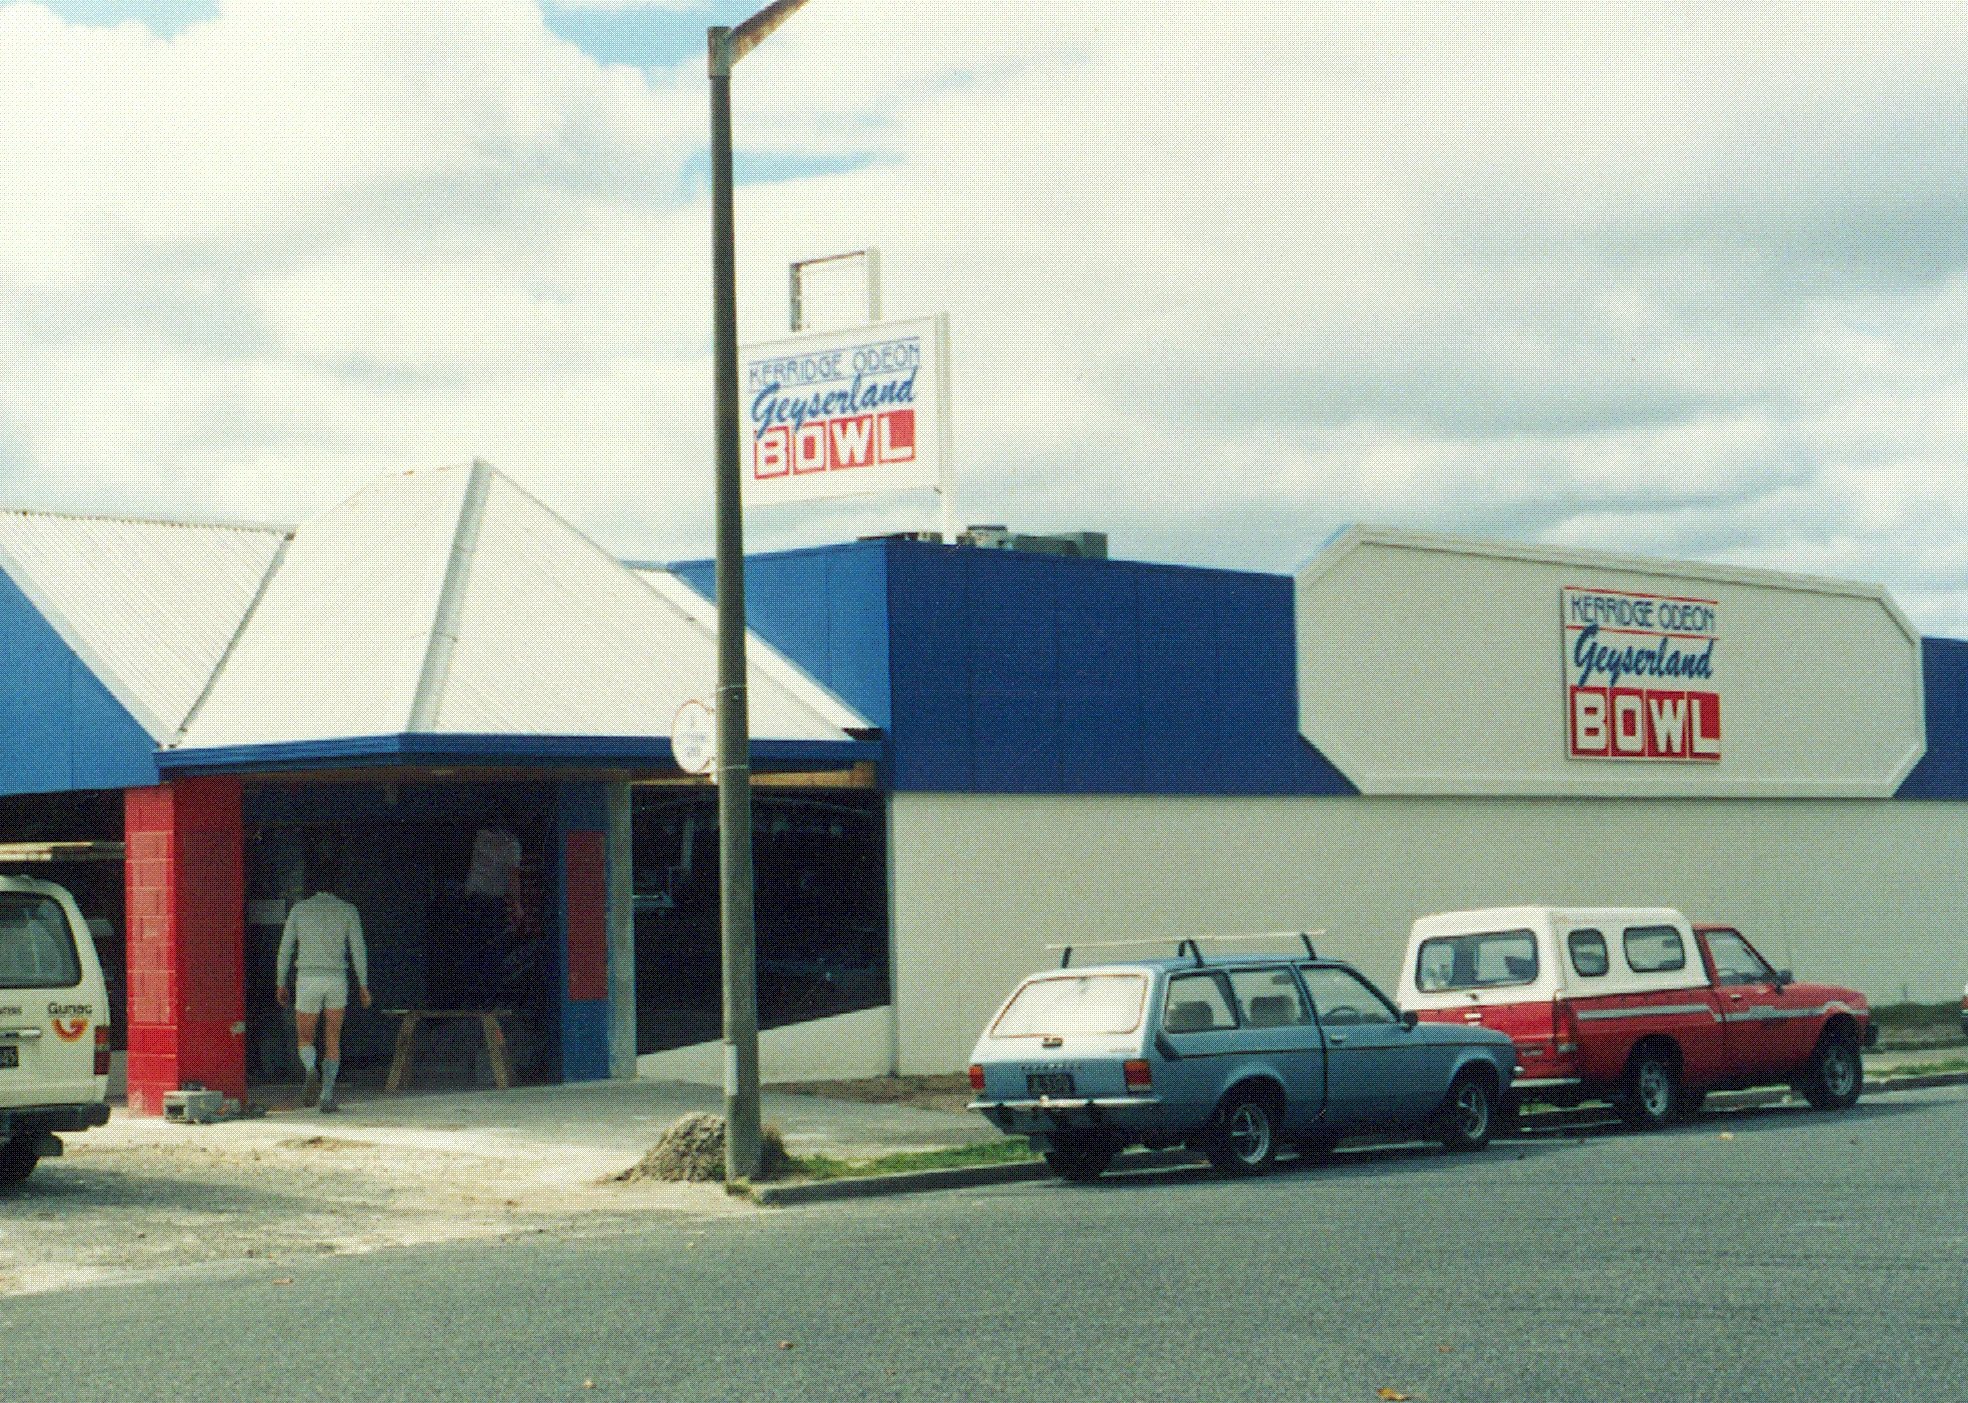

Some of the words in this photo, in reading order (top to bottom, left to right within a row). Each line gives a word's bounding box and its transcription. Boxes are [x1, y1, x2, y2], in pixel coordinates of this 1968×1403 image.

[750, 353, 842, 387] KERRIDGE
[852, 344, 920, 373] ODEON
[751, 365, 919, 440] Geyserland
[754, 411, 915, 478] BOWL
[1571, 595, 1653, 626] KERRIDGE
[1658, 603, 1715, 631] ODEON
[1573, 624, 1715, 687] Geyserland
[1572, 688, 1721, 757] BOWL
